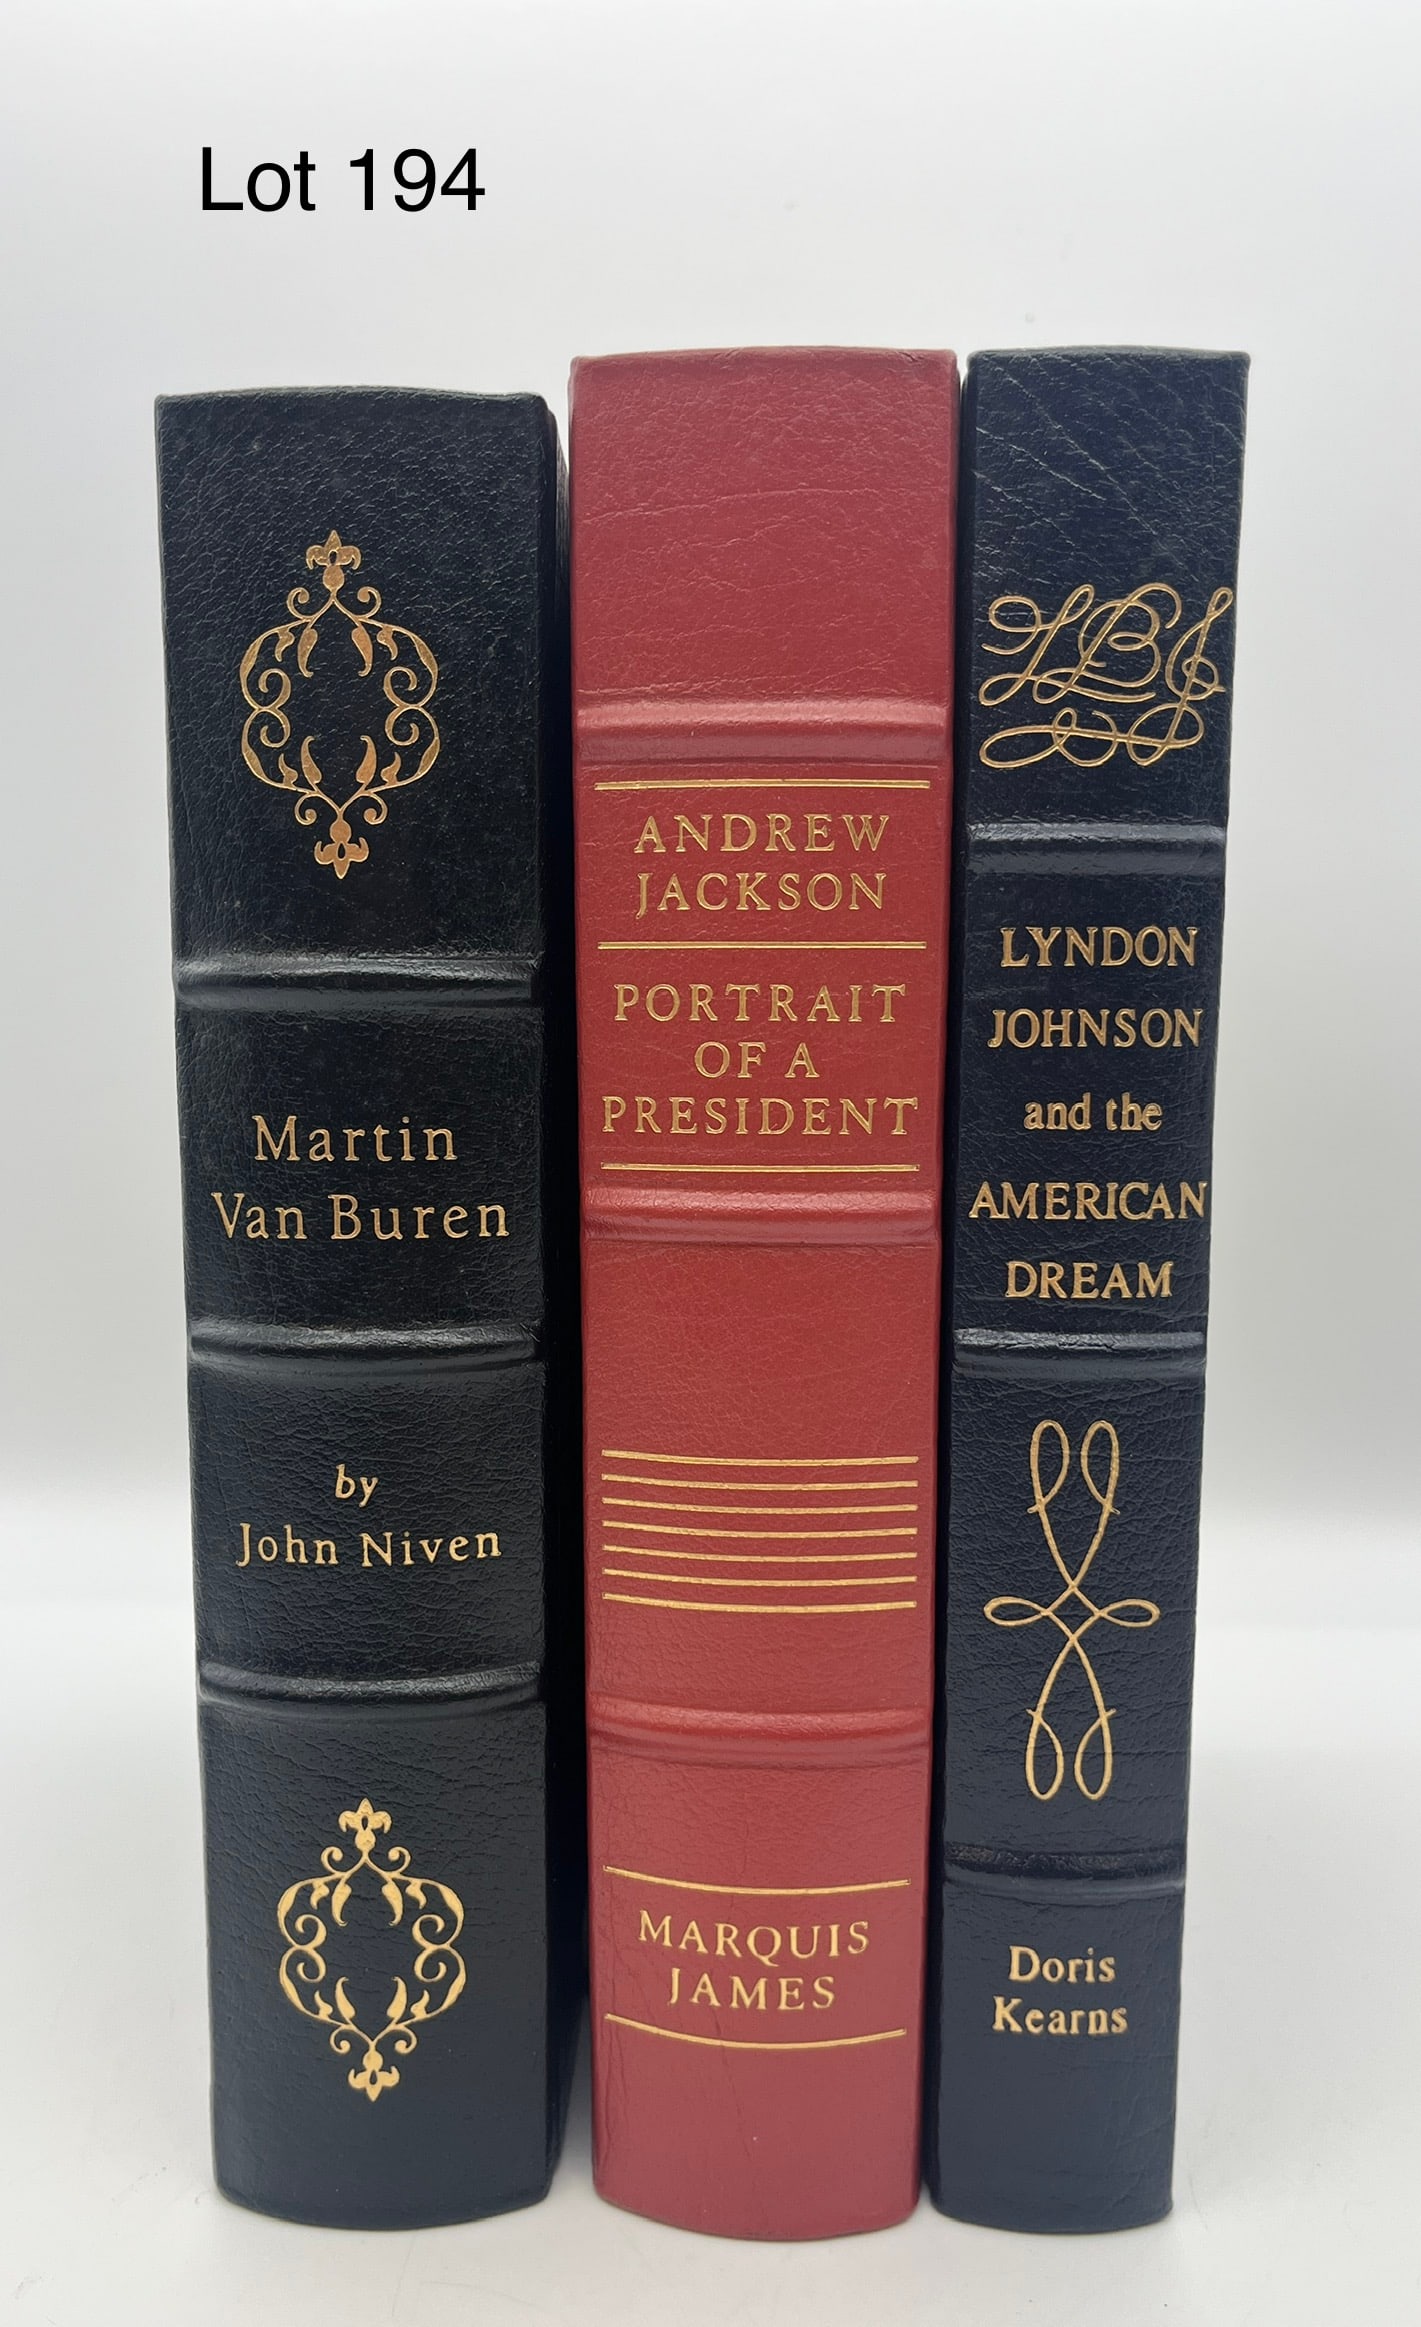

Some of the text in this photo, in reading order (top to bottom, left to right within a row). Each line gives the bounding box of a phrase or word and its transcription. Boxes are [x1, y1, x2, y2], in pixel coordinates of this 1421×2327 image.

[634, 814, 889, 853] ANDREW
[637, 872, 886, 917] JACKSON
[1001, 925, 1197, 967] LYNDON
[614, 984, 905, 1022] PORTRAIT
[988, 1009, 1201, 1048] JOHNSON
[695, 1042, 819, 1078] OF A
[603, 1096, 917, 1134] PRESIDENT
[1024, 1093, 1162, 1130] and the
[254, 1115, 456, 1161] Martin
[212, 1193, 509, 1240] Van Buren
[969, 1182, 1206, 1220] AMERICAN
[1006, 1261, 1173, 1298] DREAM
[336, 1464, 378, 1507] by
[238, 1523, 501, 1566] John Niven
[639, 1910, 868, 1967] MARQUIS
[1010, 1946, 1115, 1982] Doris
[667, 1967, 834, 2010] JAMES
[994, 1997, 1127, 2034] Kearns
